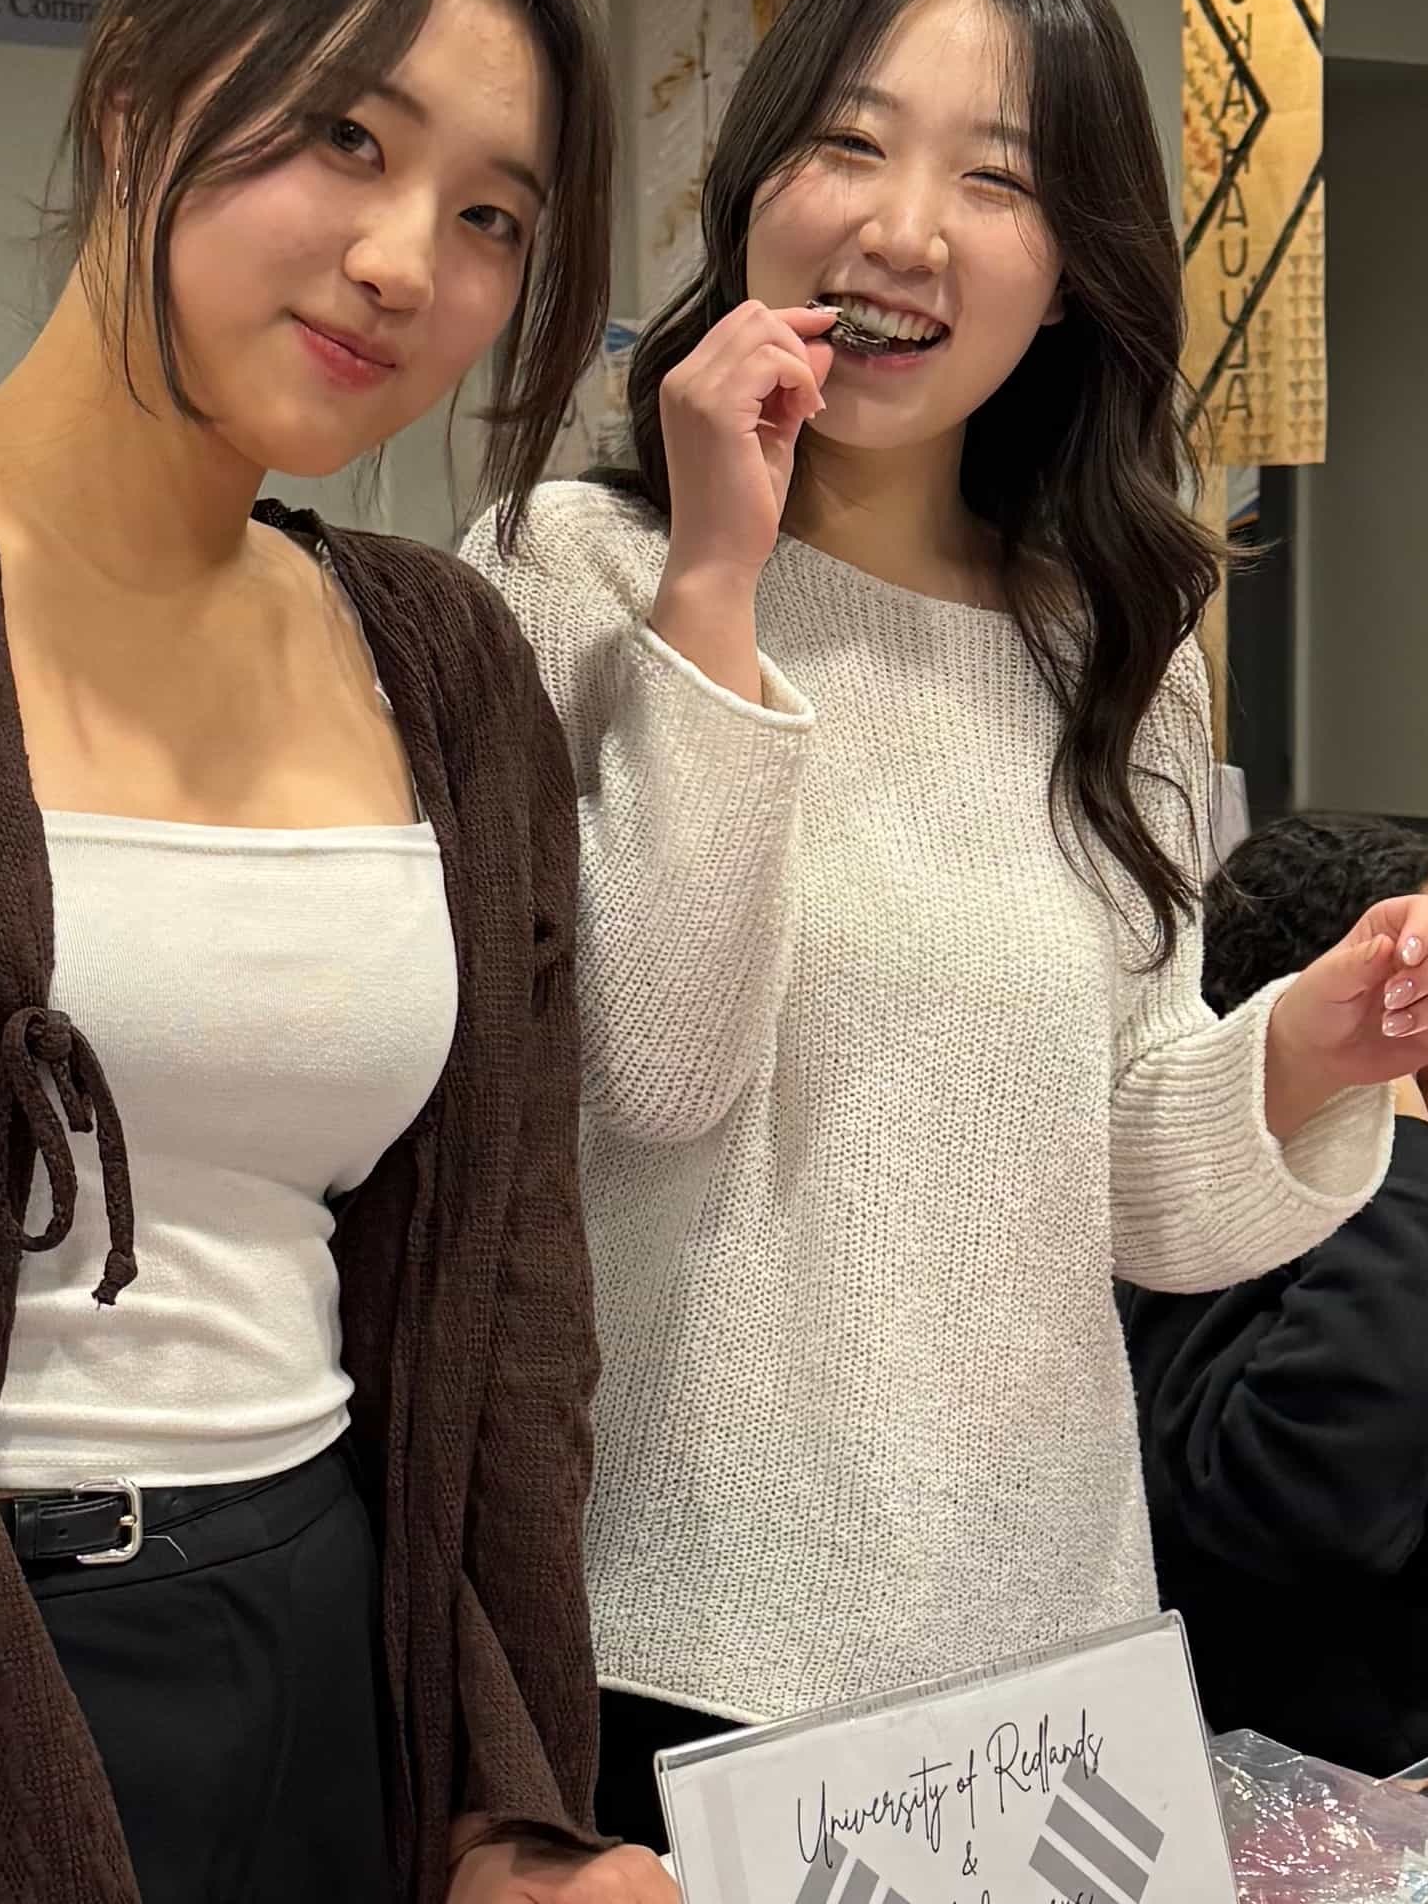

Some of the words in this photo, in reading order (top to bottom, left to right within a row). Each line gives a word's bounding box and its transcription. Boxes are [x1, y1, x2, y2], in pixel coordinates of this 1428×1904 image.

[797, 1756, 953, 1869] University
[956, 1748, 978, 1829] of
[986, 1707, 1104, 1814] Redlands
[961, 1839, 978, 1876] &
